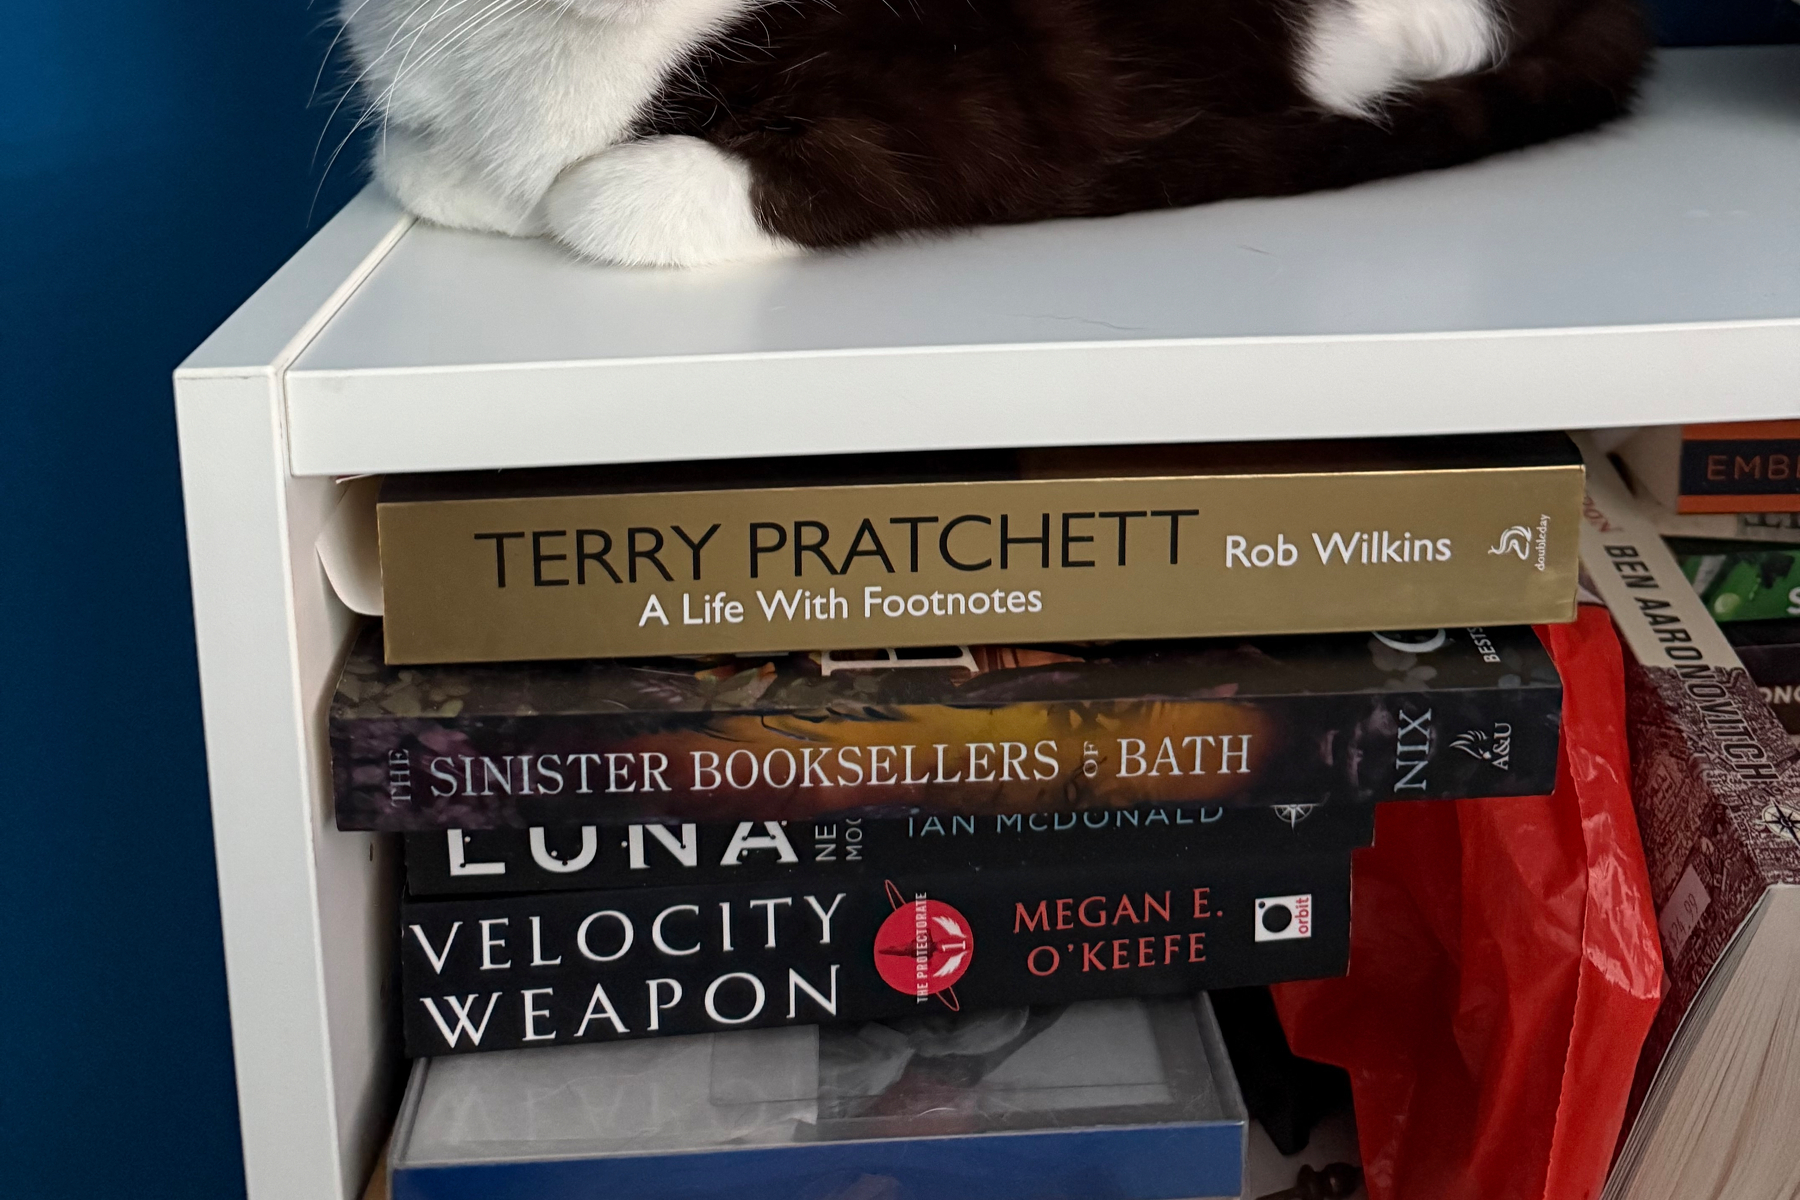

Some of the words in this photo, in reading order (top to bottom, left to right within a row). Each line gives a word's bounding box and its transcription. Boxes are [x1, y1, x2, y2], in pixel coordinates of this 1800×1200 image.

[1706, 453, 1800, 481] EMB
[473, 523, 722, 588] TERRY
[749, 509, 1200, 579] PRATCHETT
[1225, 533, 1298, 568] Rob
[1311, 530, 1452, 566] Wilkins
[1534, 513, 1550, 571] doubleday
[638, 594, 670, 627] A
[683, 591, 744, 626] Life
[756, 586, 849, 622] With
[863, 585, 1043, 619] Footnotes
[1602, 544, 1660, 589] BEN
[1633, 596, 1782, 782] AARONOVITCH
[388, 749, 412, 807] THE
[430, 752, 672, 797] SINISTER
[689, 740, 1060, 791] BOOKSELLERS
[1083, 741, 1100, 778] OF
[1115, 734, 1252, 778] BATH
[1394, 708, 1432, 793] NIX
[1492, 722, 1512, 770] A&U
[447, 820, 799, 876] LUNA
[908, 815, 975, 837] IAN
[409, 893, 846, 975] VELOCITY
[915, 892, 929, 980] PROTECTORATE
[1013, 890, 1171, 934] MEGAN
[1193, 887, 1224, 919] E.
[1294, 896, 1310, 935] orbit
[1027, 932, 1206, 977] O'KEEFE
[419, 964, 840, 1049] WEAPON
[916, 982, 929, 1004] THE
